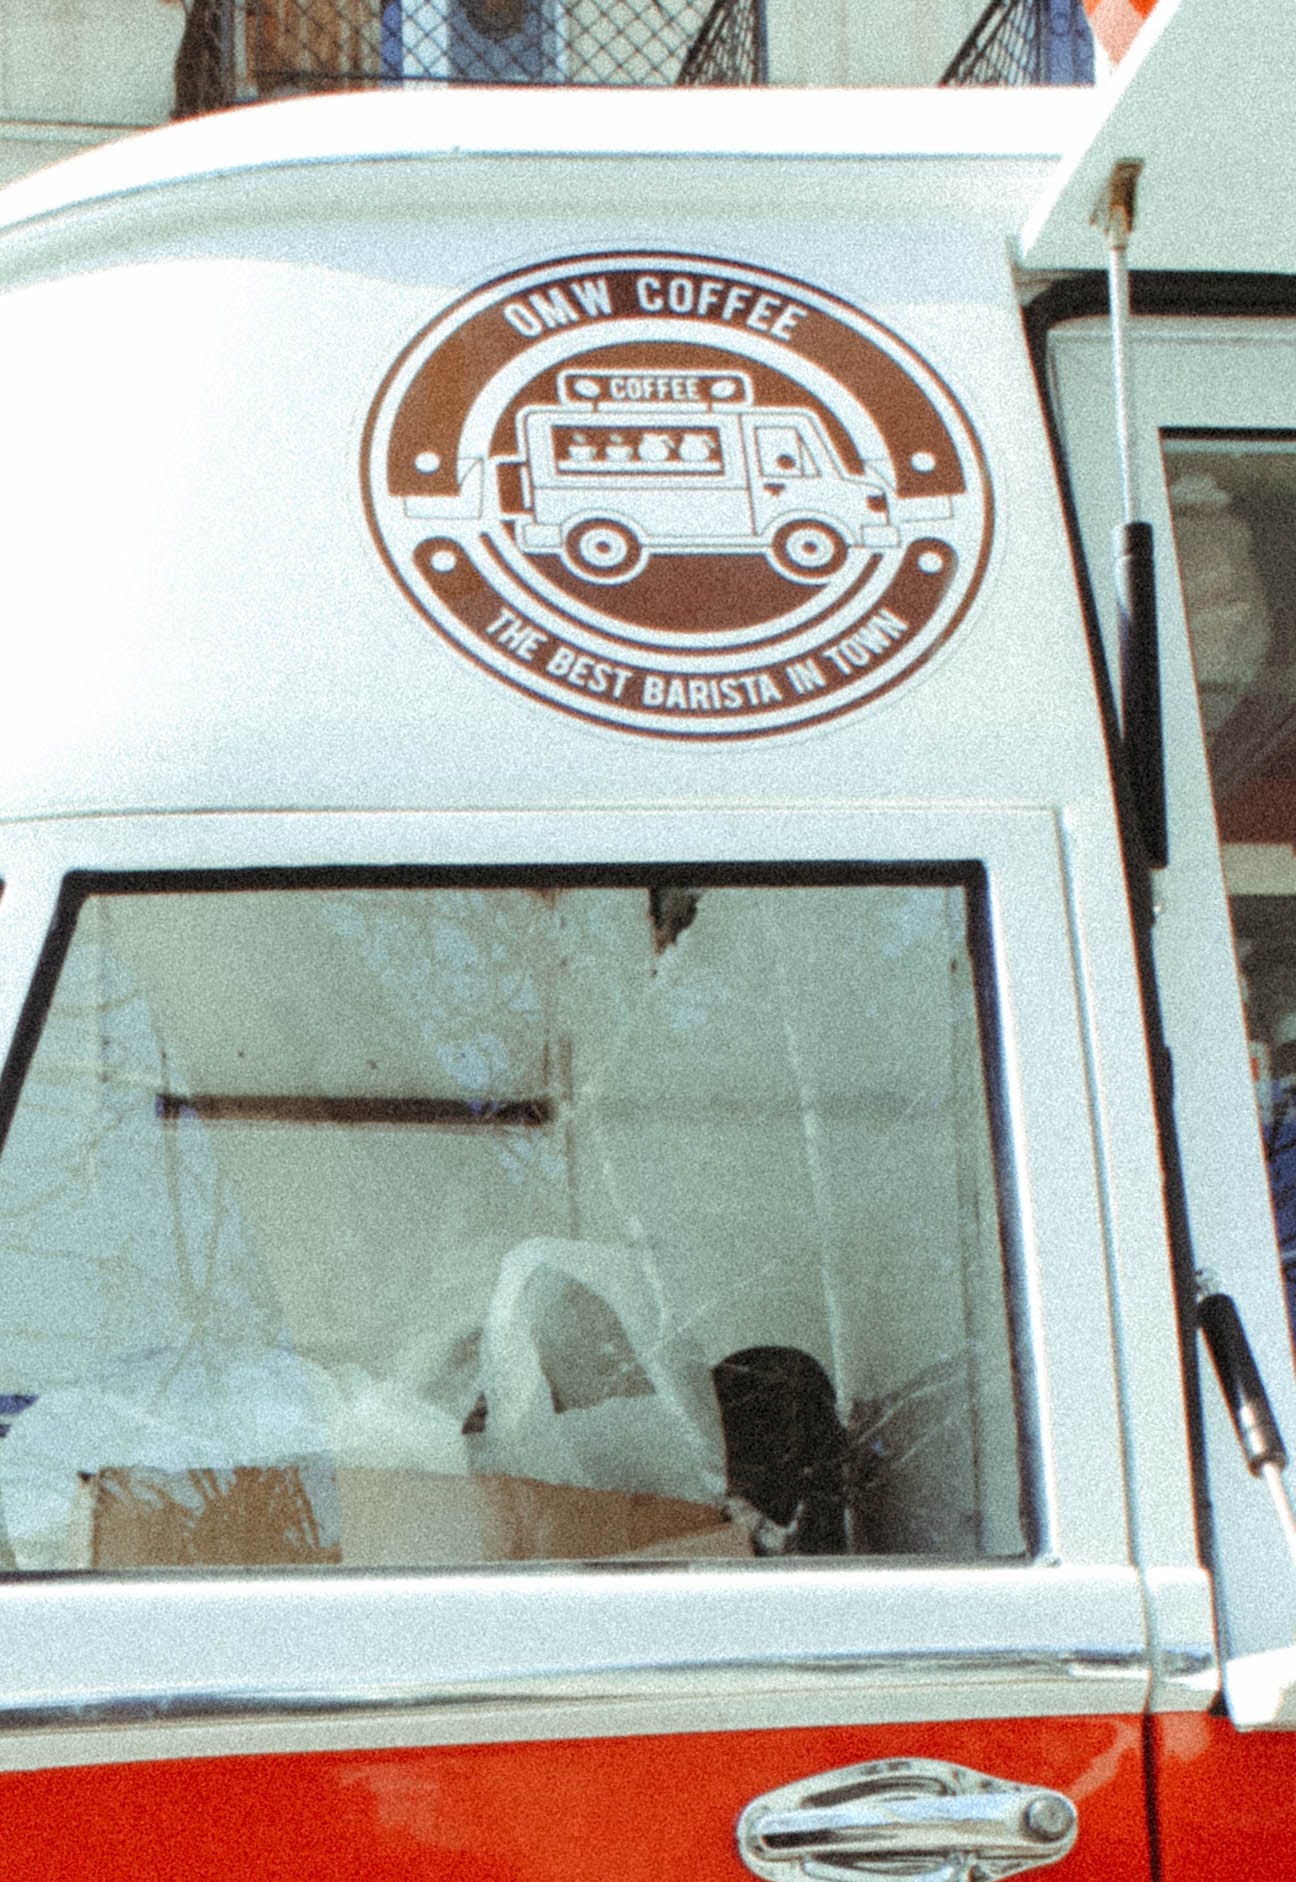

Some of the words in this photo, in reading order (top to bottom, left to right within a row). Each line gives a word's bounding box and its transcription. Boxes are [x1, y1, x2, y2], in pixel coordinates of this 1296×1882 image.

[503, 278, 613, 339] OMW
[636, 275, 808, 341] COFFEE
[608, 377, 701, 401] COFFEE
[485, 608, 549, 664] THE
[545, 646, 633, 700] BEST
[641, 672, 784, 711] BARISTA
[785, 658, 827, 696] IN
[822, 607, 909, 676] TOWN
